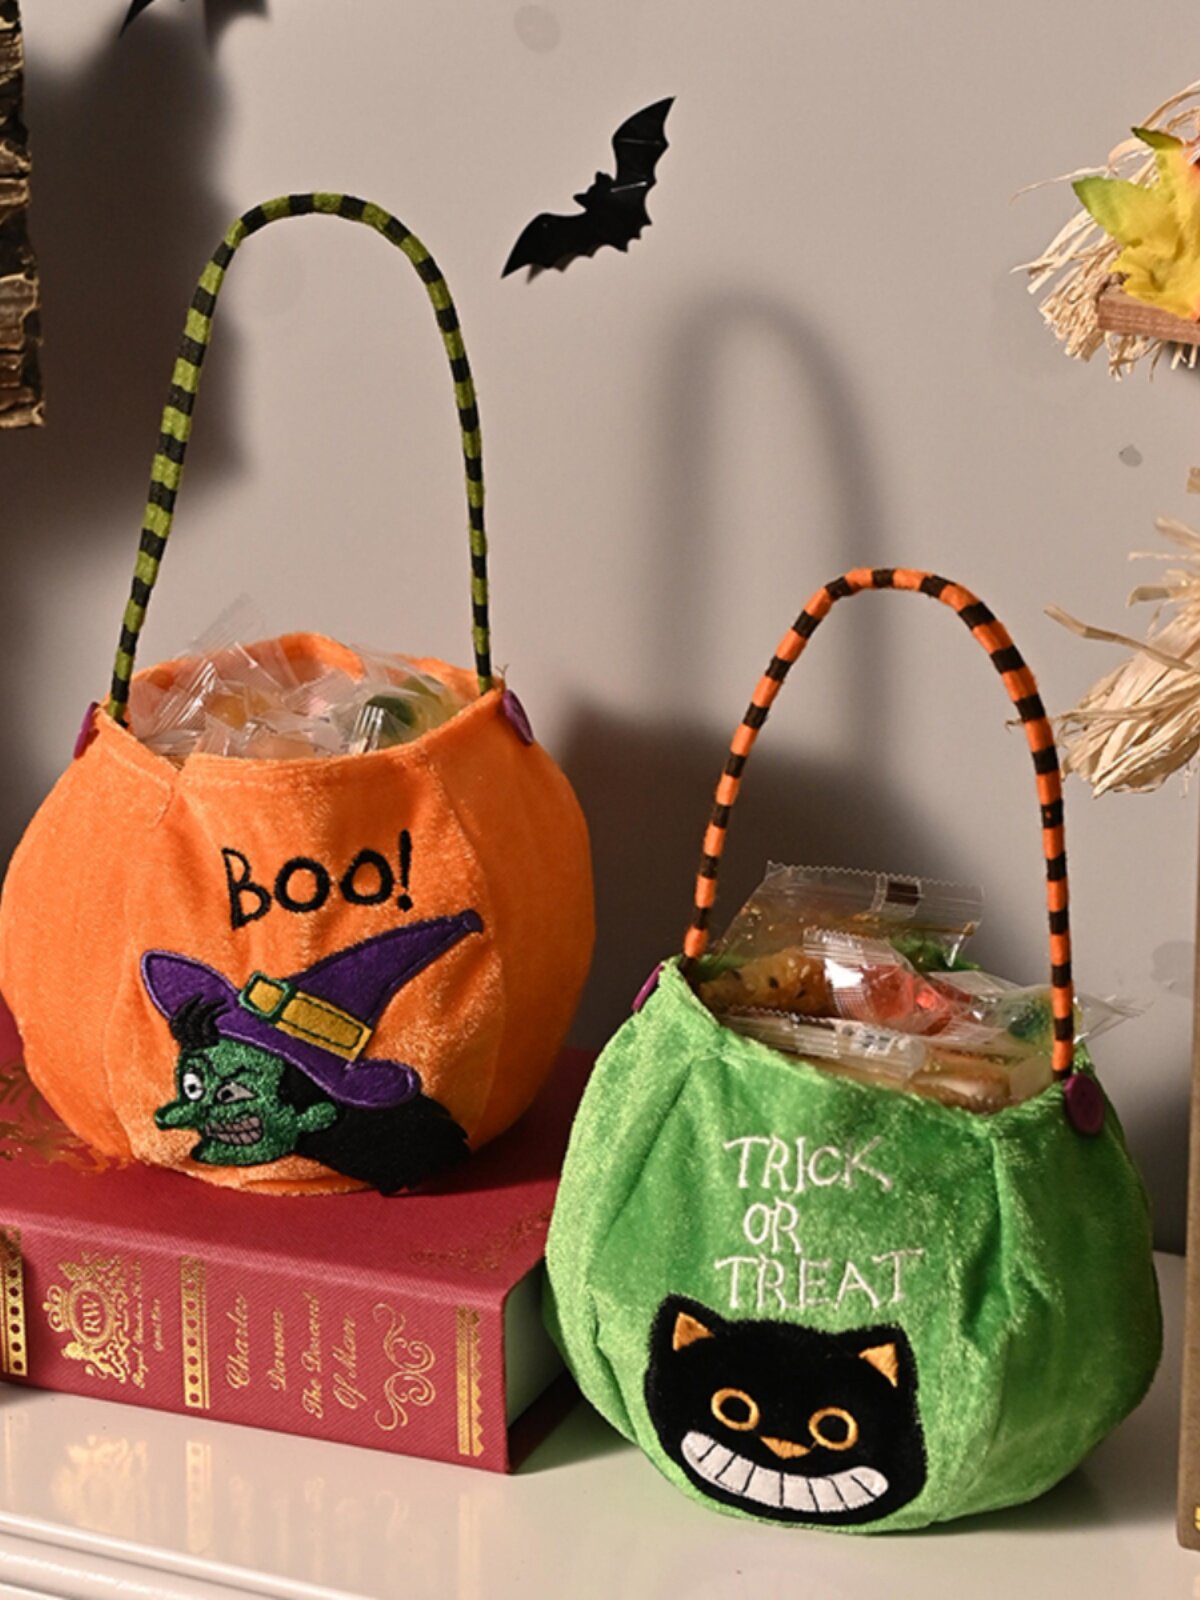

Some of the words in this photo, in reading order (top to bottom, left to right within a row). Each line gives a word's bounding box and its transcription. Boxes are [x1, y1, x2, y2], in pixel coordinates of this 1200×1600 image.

[221, 829, 413, 930] BOO!
[724, 1135, 893, 1193] TRICK
[743, 1197, 802, 1253] OR
[714, 1248, 925, 1310] TREAT
[82, 1294, 101, 1332] RW
[225, 1292, 250, 1389] Charles
[302, 1378, 323, 1419] The
[333, 1373, 368, 1410] Of
